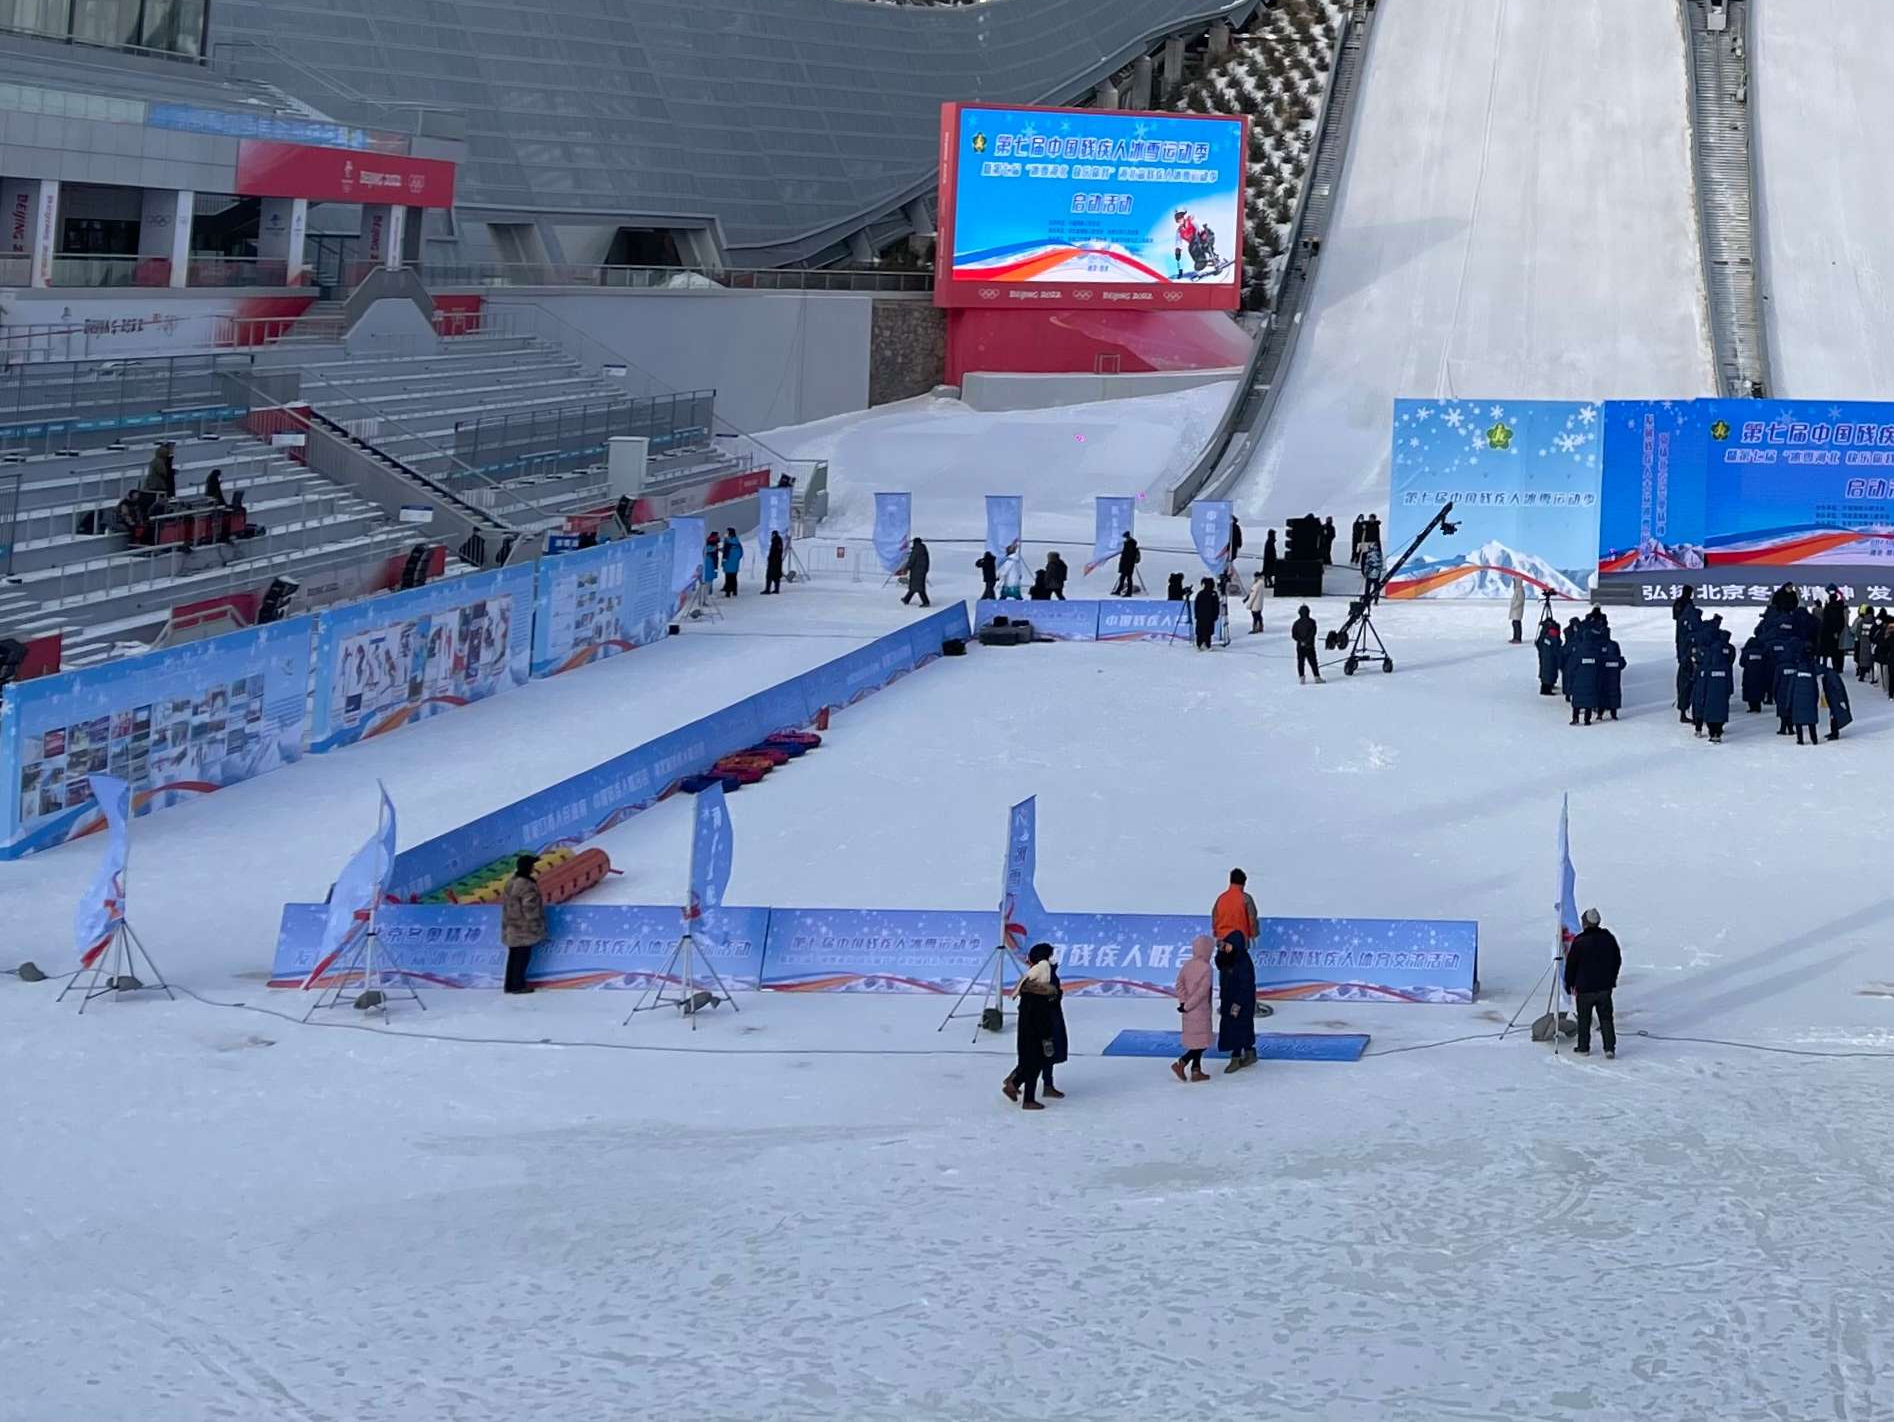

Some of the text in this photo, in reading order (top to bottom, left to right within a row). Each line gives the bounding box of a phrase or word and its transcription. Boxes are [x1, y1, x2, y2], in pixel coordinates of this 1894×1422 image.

[994, 134, 1210, 164] 第七届中国残疾人冰雪运动季
[11, 194, 29, 240] BEIJING
[1070, 192, 1134, 215] 启动活动
